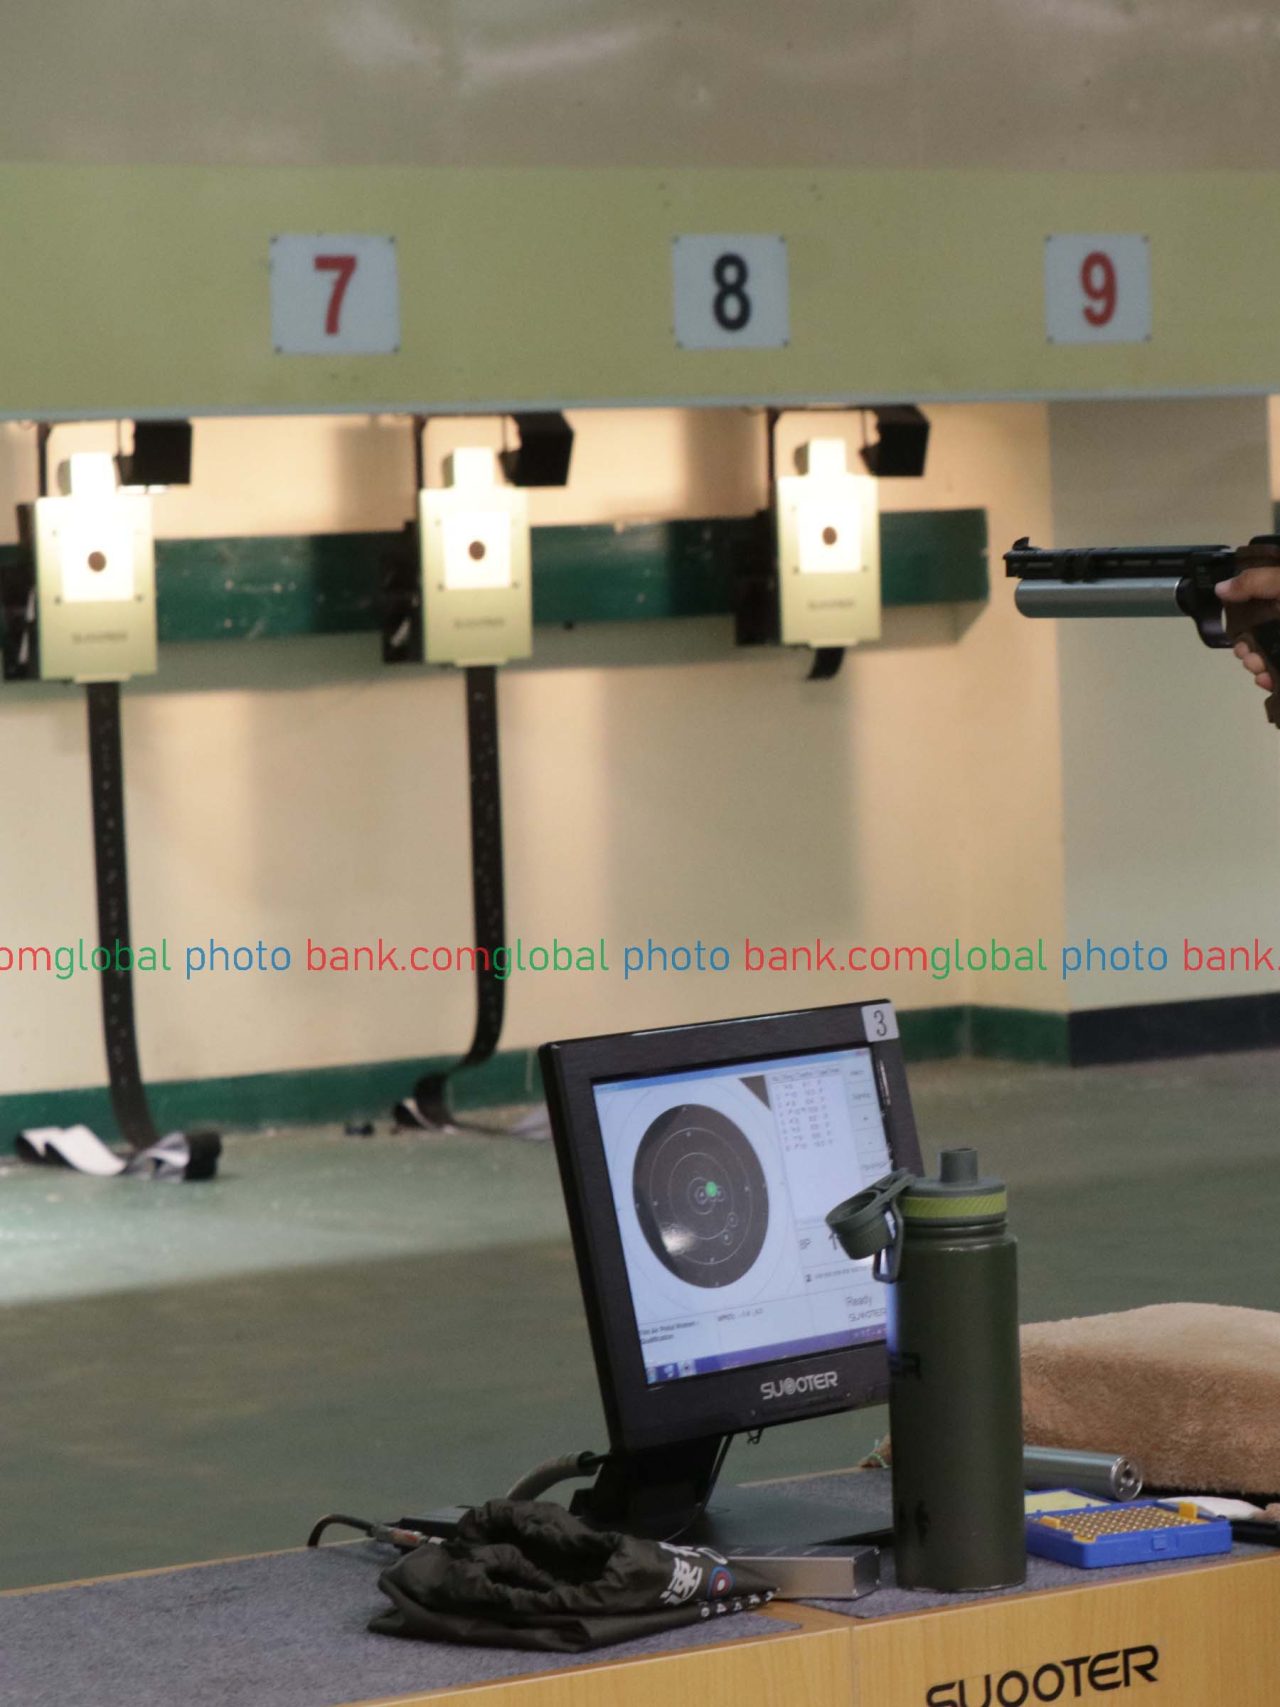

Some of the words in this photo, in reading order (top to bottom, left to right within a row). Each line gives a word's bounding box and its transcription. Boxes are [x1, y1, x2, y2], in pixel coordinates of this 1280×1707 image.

[314, 254, 358, 334] 7
[711, 252, 753, 332] 8
[1081, 252, 1117, 327] 9
[874, 1008, 889, 1037] 3
